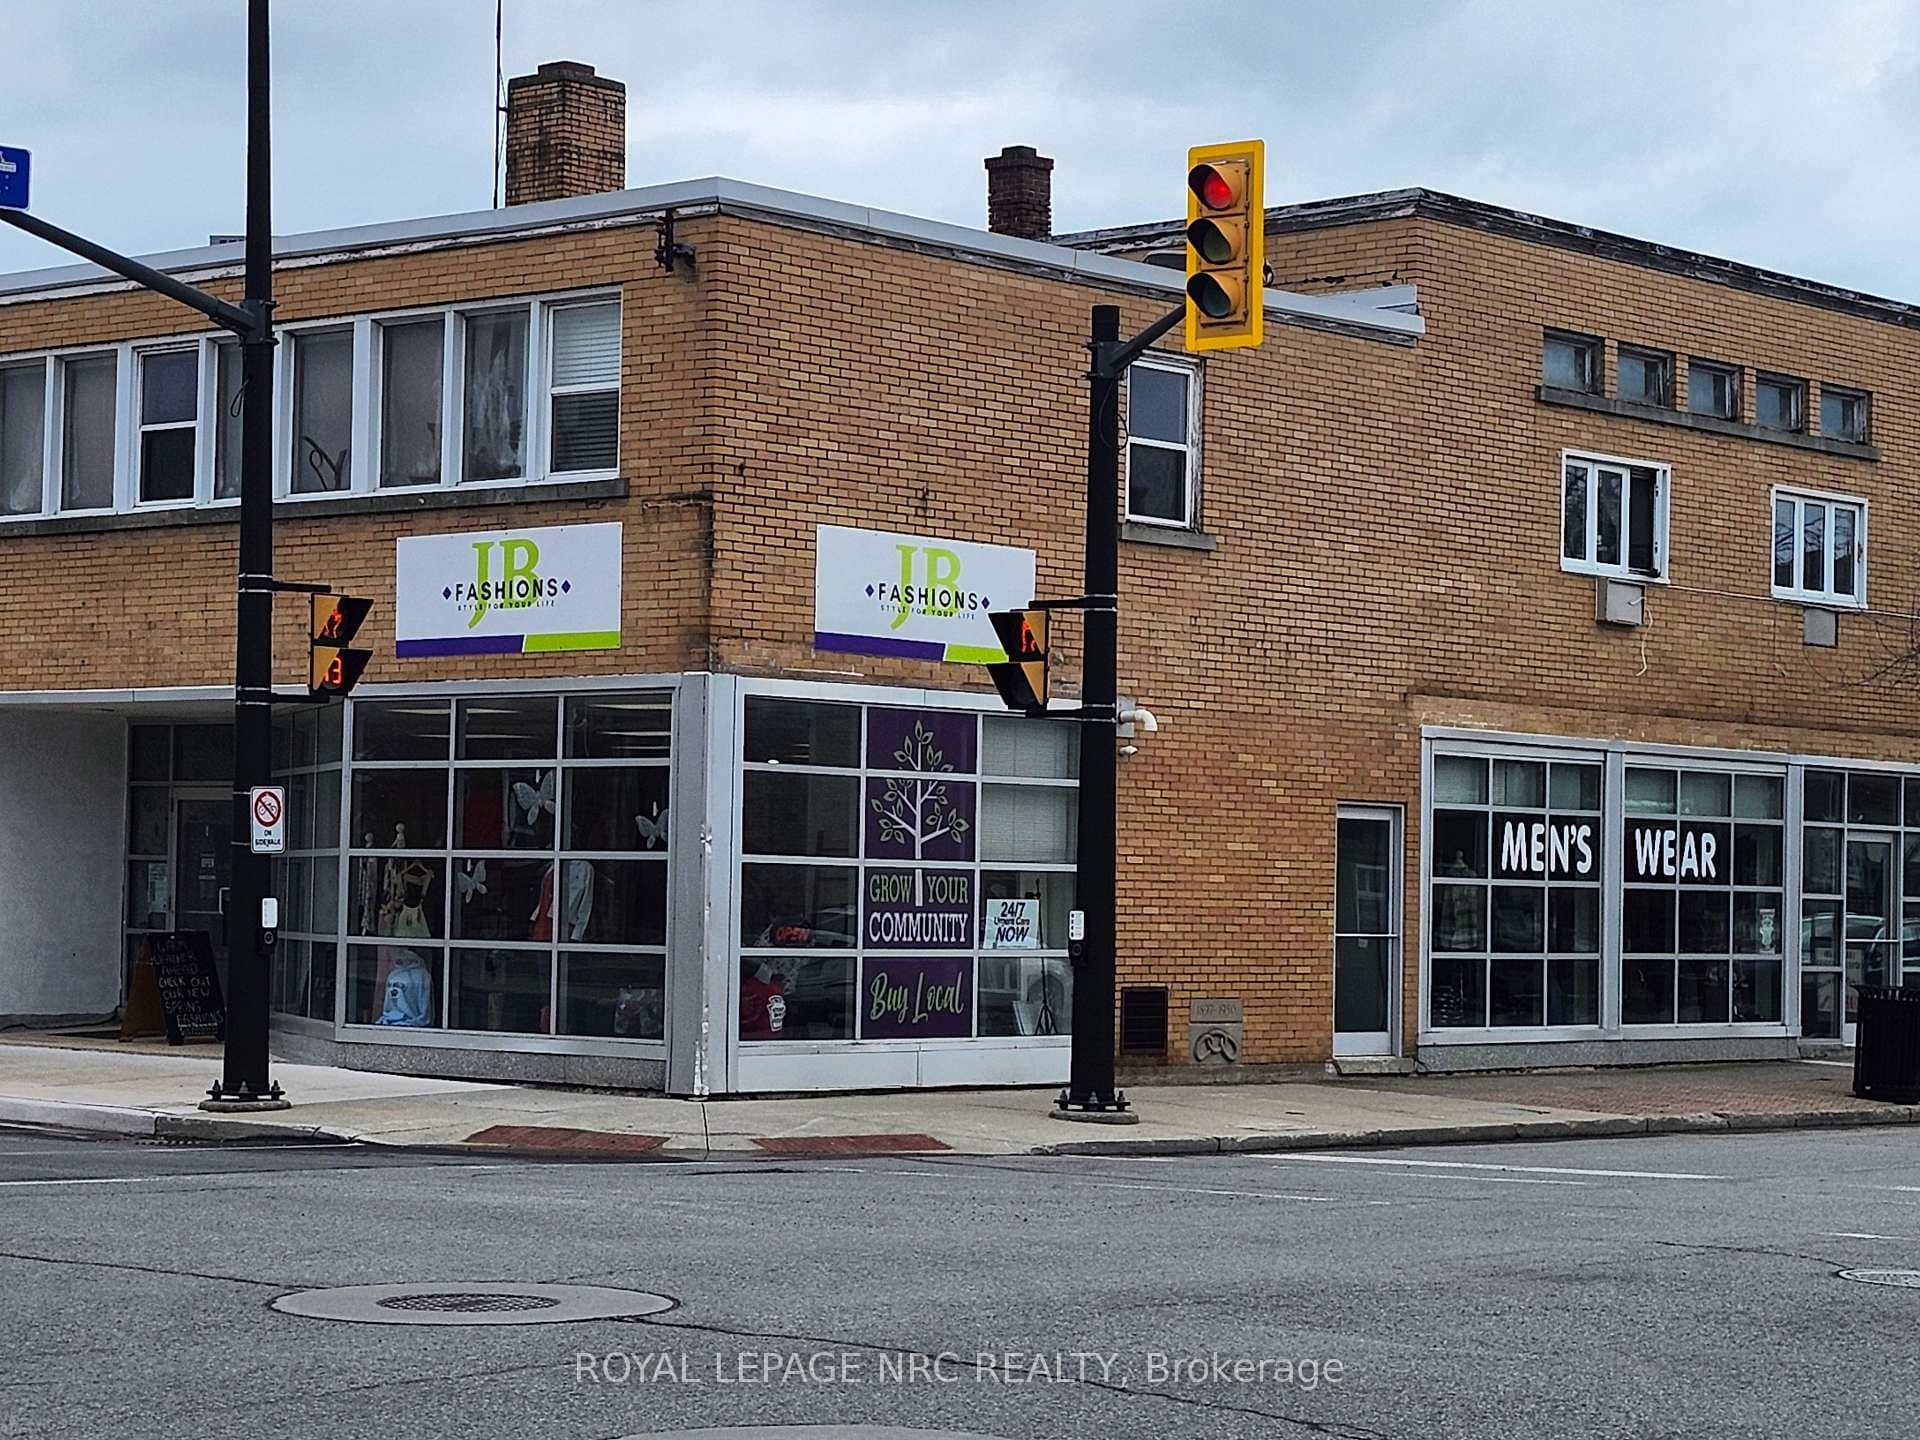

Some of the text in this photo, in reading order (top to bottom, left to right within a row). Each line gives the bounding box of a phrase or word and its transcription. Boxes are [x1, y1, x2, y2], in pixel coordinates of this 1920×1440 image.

[455, 577, 558, 601] FASHIONS
[468, 538, 540, 629] JB
[878, 582, 978, 610] FASHIONS
[890, 544, 961, 630] JB
[1501, 821, 1718, 878] MEN'S WEAR
[869, 874, 969, 904] GROW YOUR
[1000, 901, 1027, 917] 24/7
[868, 912, 969, 943] COMMUNITY
[995, 926, 1030, 942] NOW
[869, 971, 964, 1024] Buy Local
